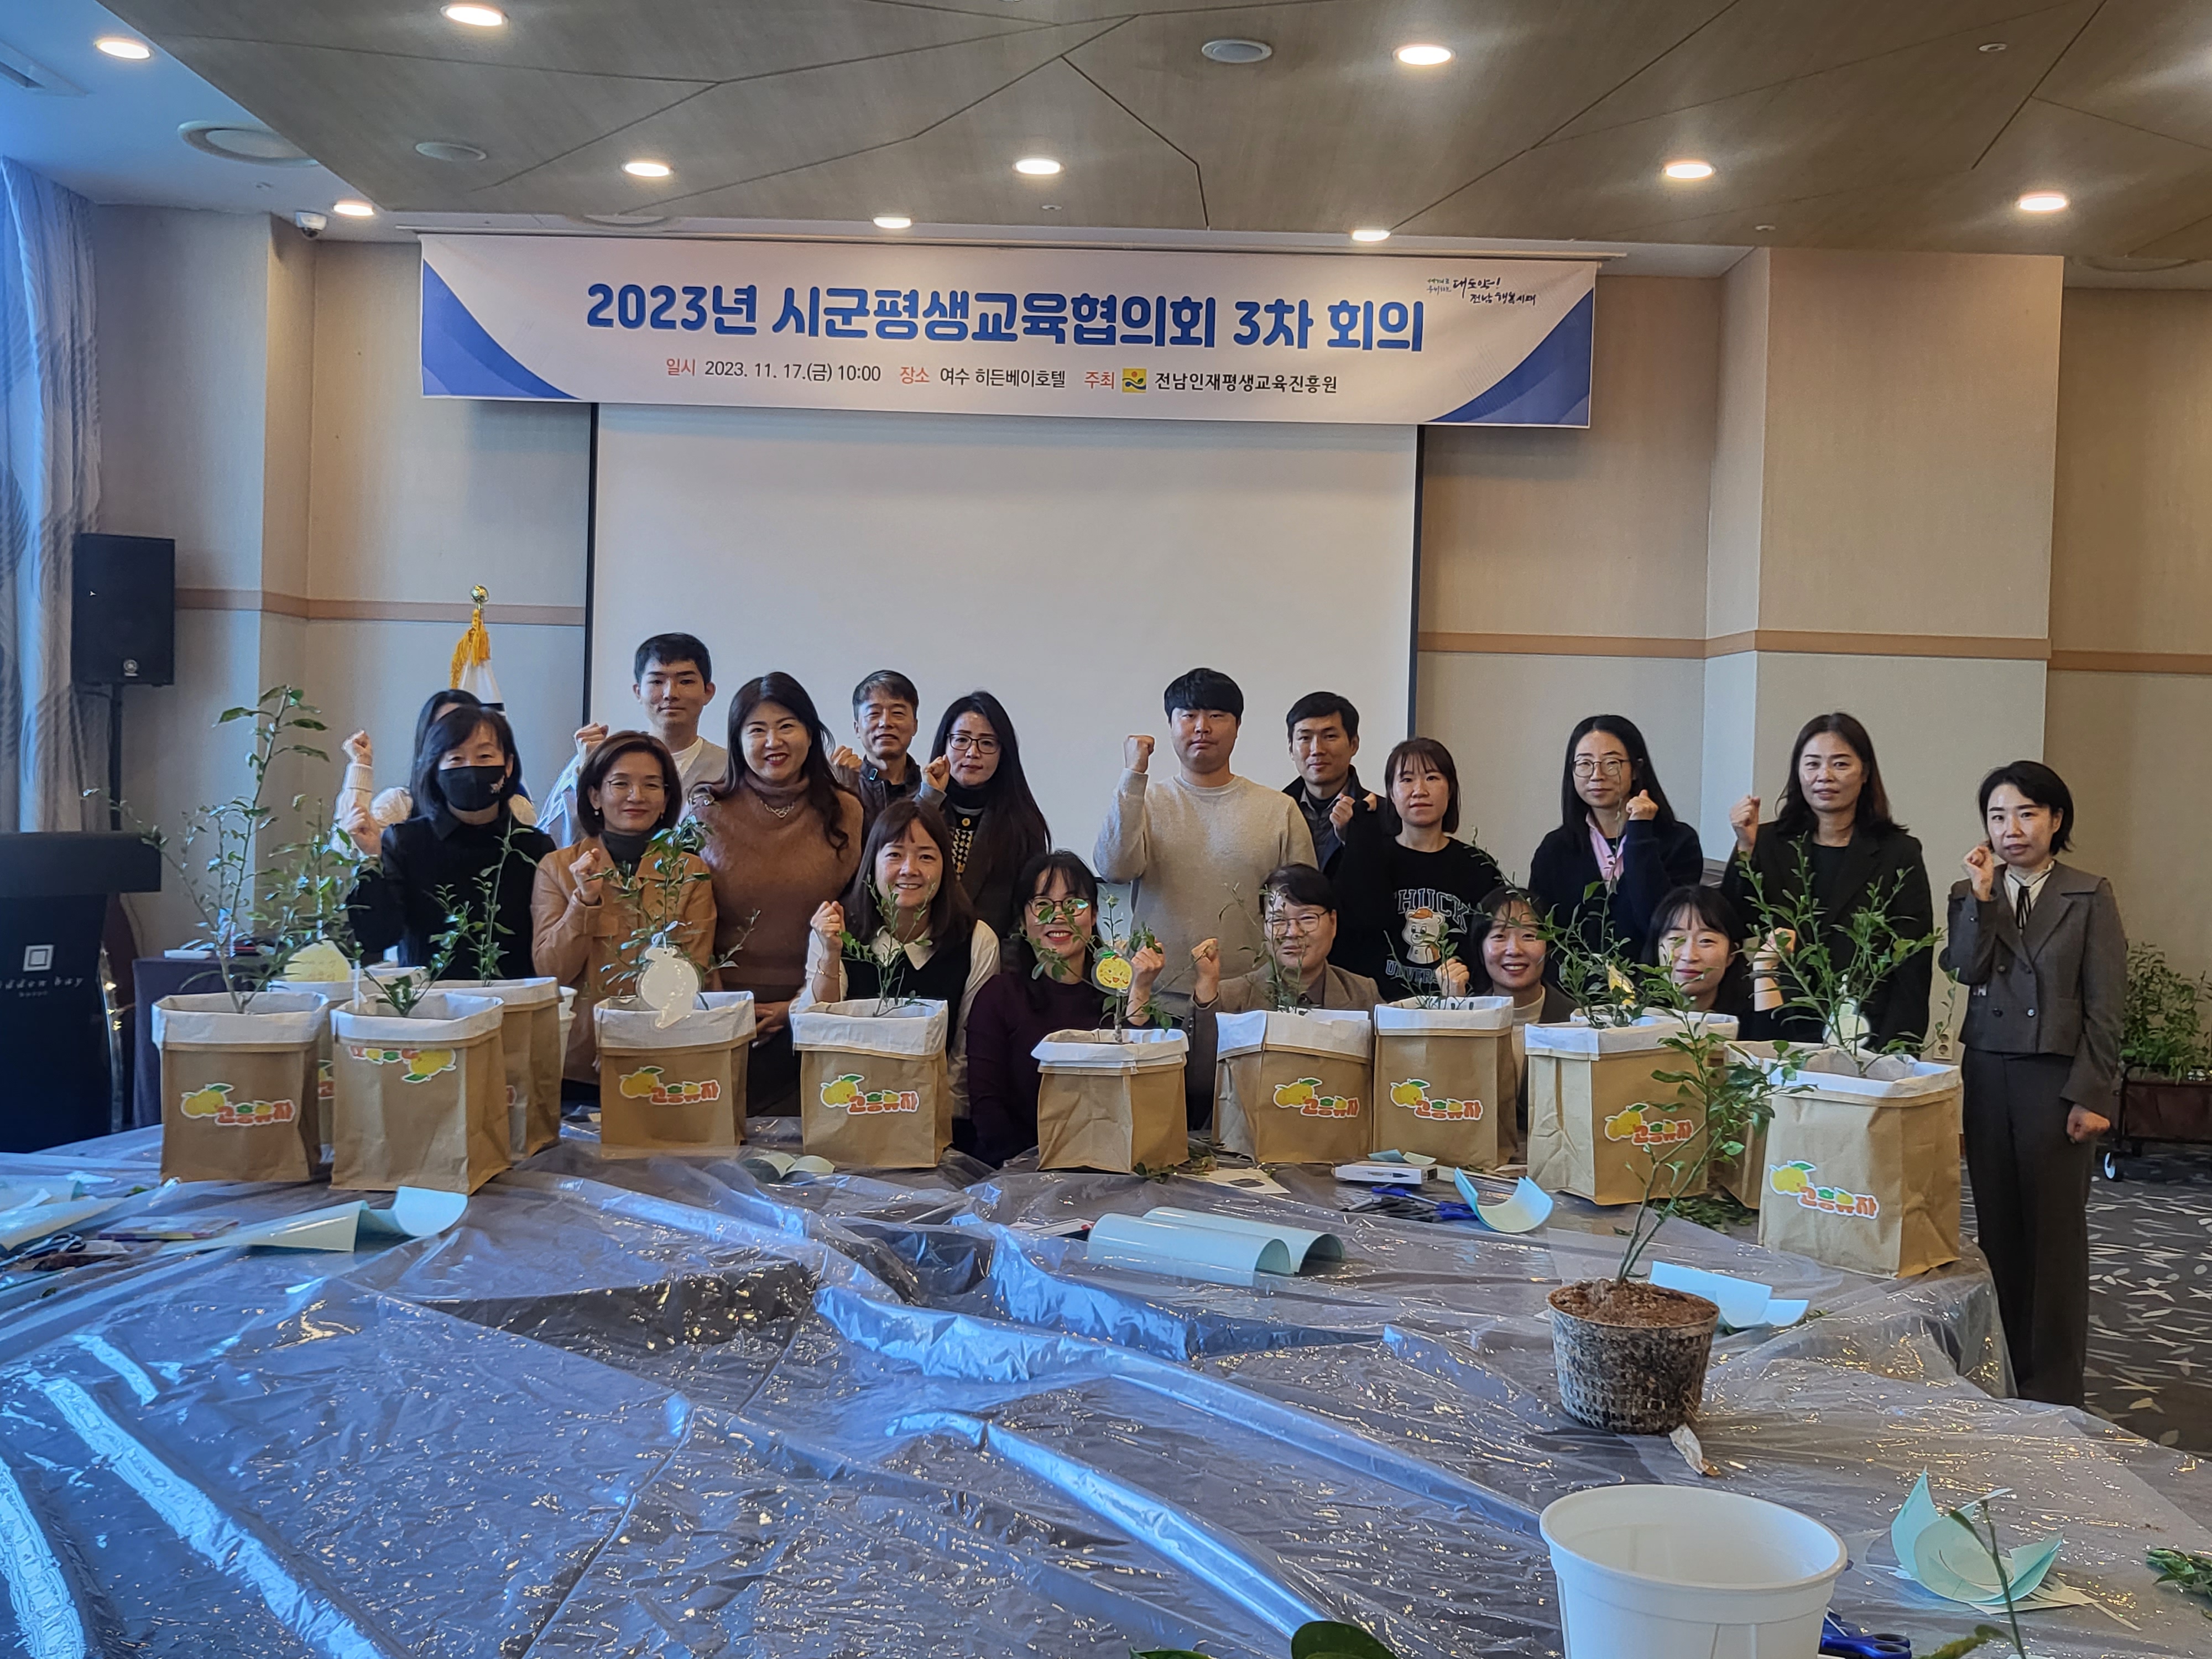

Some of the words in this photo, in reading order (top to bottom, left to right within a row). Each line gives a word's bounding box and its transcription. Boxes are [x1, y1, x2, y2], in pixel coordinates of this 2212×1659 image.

[1470, 293, 1493, 304] 전남
[587, 283, 757, 336] 2023년
[772, 286, 1215, 349] 시군평생교육협의회
[1233, 298, 1314, 349] 3차
[1327, 300, 1423, 352] 회의
[666, 358, 696, 377] 일시
[705, 361, 748, 377] 2023.
[754, 363, 777, 378] 11.
[784, 363, 832, 382] 17.(금)
[837, 365, 881, 382] 10:00
[899, 366, 930, 385] 장소
[940, 367, 971, 385] 여수
[975, 368, 1066, 388] 히든베이호텔
[1083, 371, 1115, 389] 주최
[1154, 372, 1337, 393] 전남인재평생교육진흥원
[849, 1091, 917, 1113] 고흥유자
[1415, 1099, 1481, 1119] 고흥유자
[1799, 1186, 1877, 1217] 고흥유자
